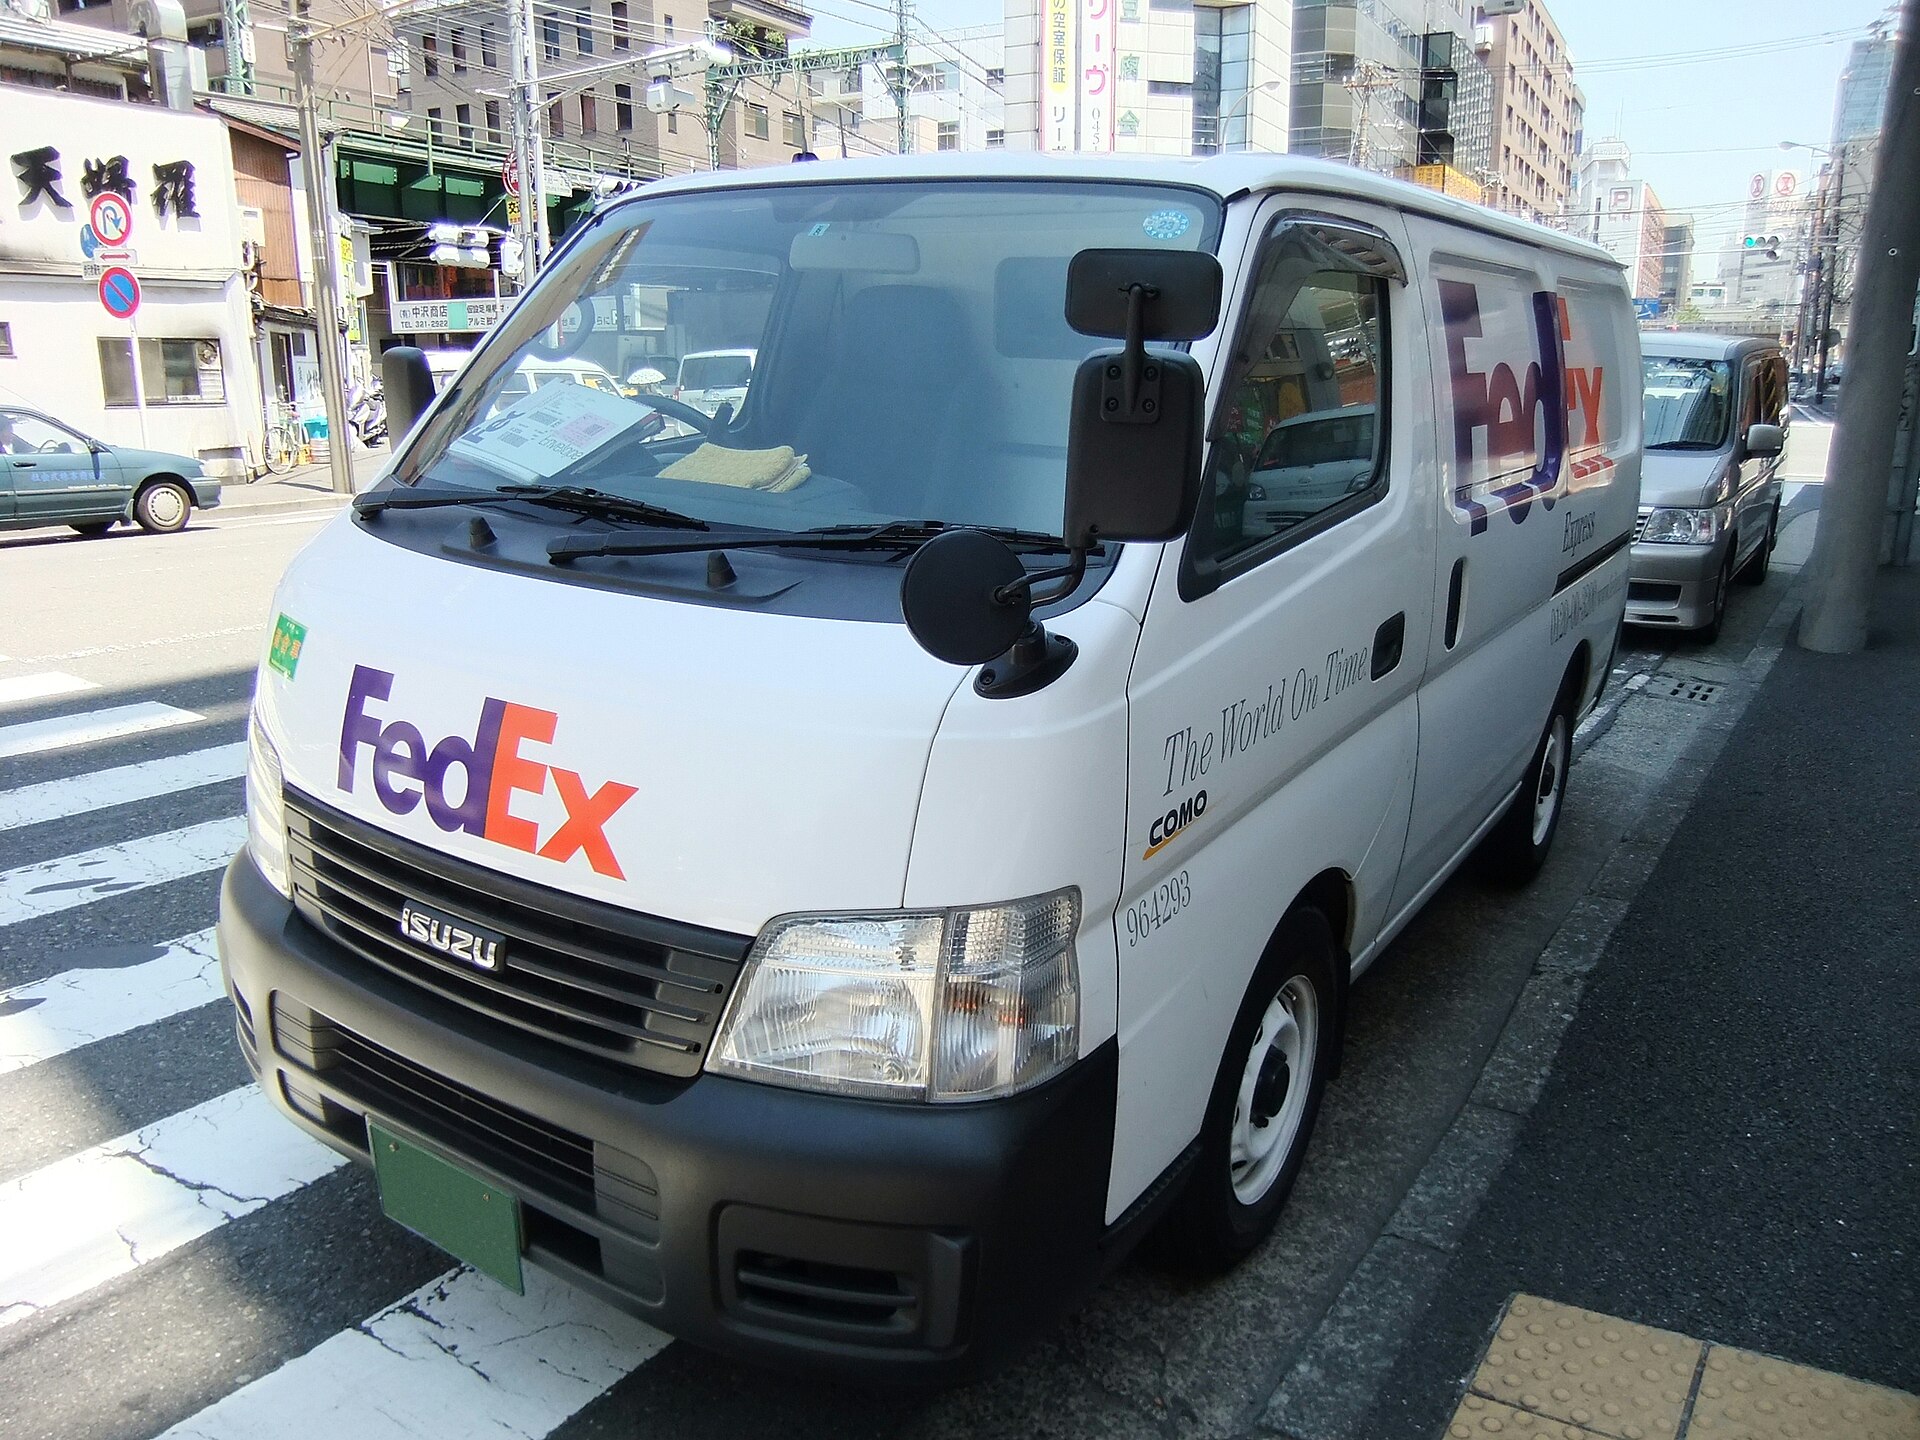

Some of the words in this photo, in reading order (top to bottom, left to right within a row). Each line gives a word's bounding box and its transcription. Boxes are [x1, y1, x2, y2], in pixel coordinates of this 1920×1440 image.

[1051, 105, 1067, 152] リー
[401, 321, 413, 329] TEL
[415, 320, 448, 328] 321-2922
[1437, 279, 1614, 538] FedEx
[1562, 511, 1596, 557] Express
[1163, 726, 1214, 798] The
[1221, 677, 1287, 765] World
[1291, 667, 1319, 721] On
[337, 663, 640, 883] FedEx
[1149, 789, 1209, 847] COMO
[400, 907, 498, 969] ISUZU
[1126, 869, 1192, 948] 964293
